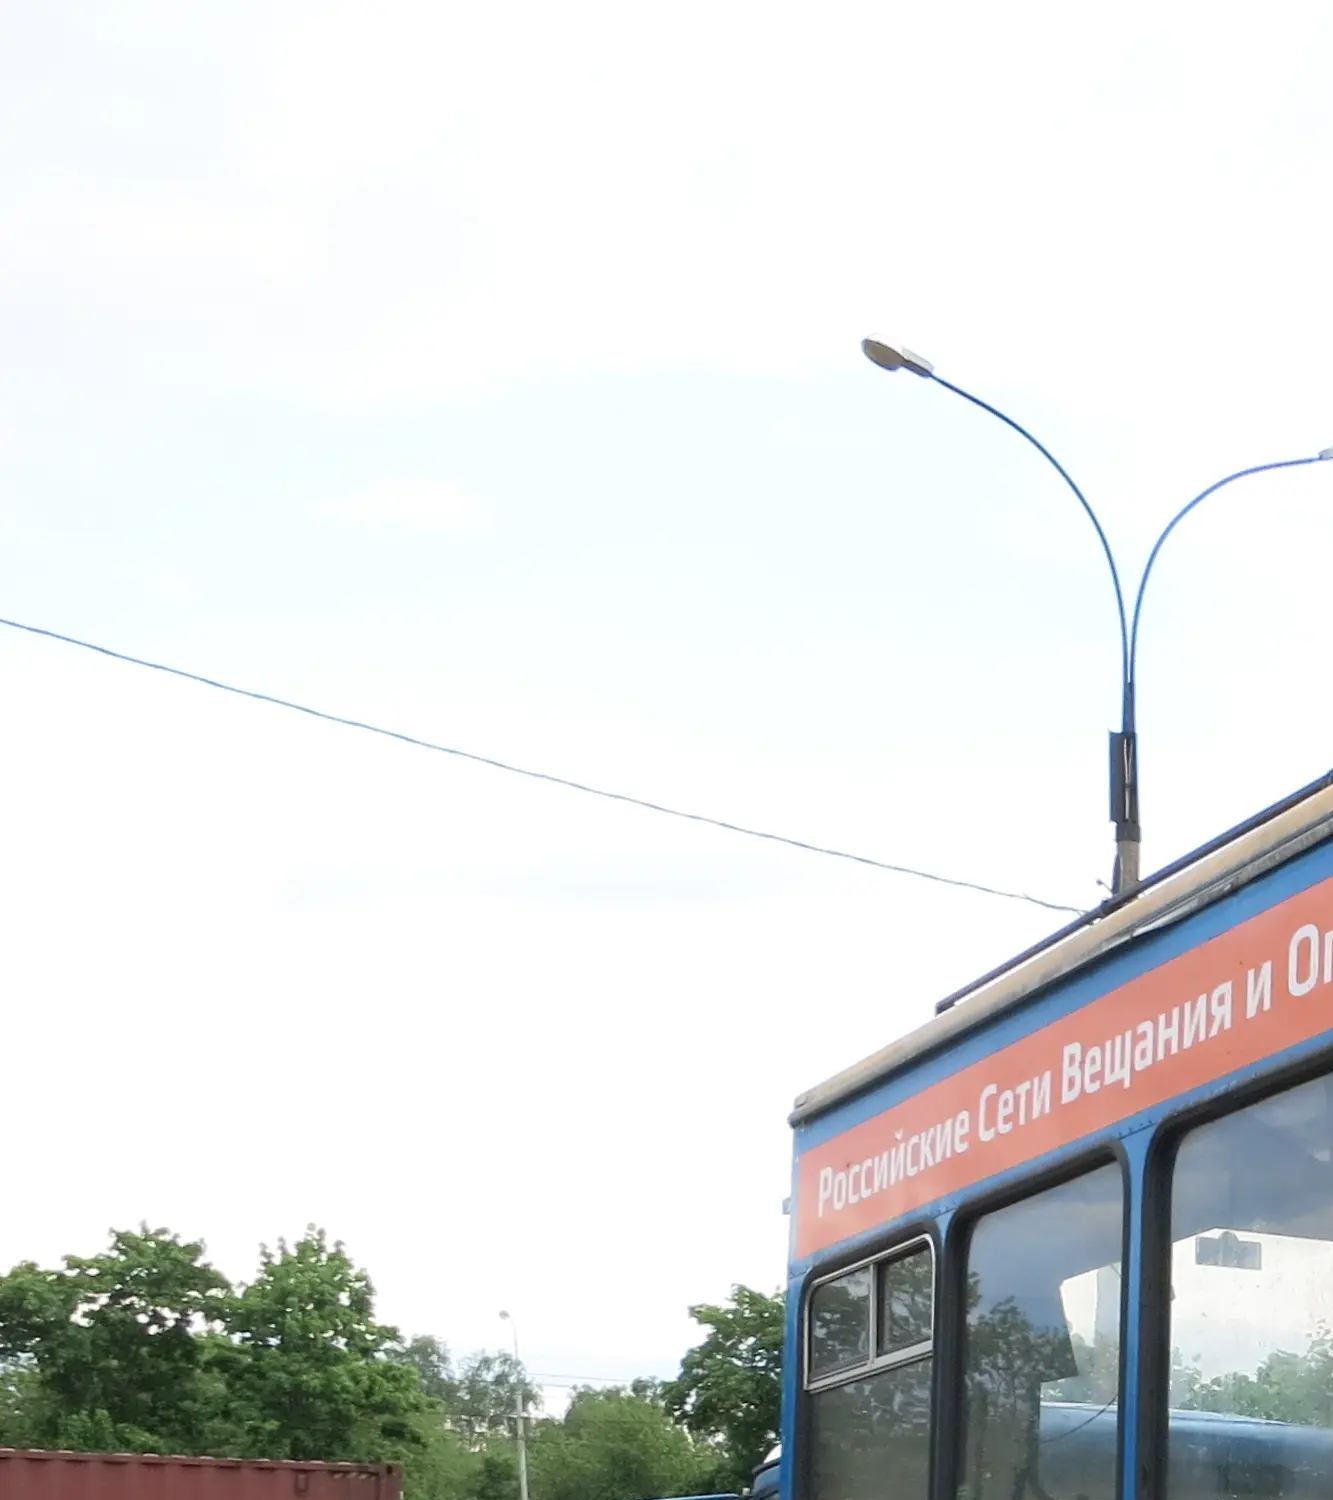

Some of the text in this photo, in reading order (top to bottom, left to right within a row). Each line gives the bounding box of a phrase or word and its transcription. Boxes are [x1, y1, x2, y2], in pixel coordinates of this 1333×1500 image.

[816, 1106, 969, 1217] Российские
[977, 1070, 1051, 1143] Сети
[1060, 979, 1234, 1105] Вещания
[1246, 960, 1273, 1020] и
